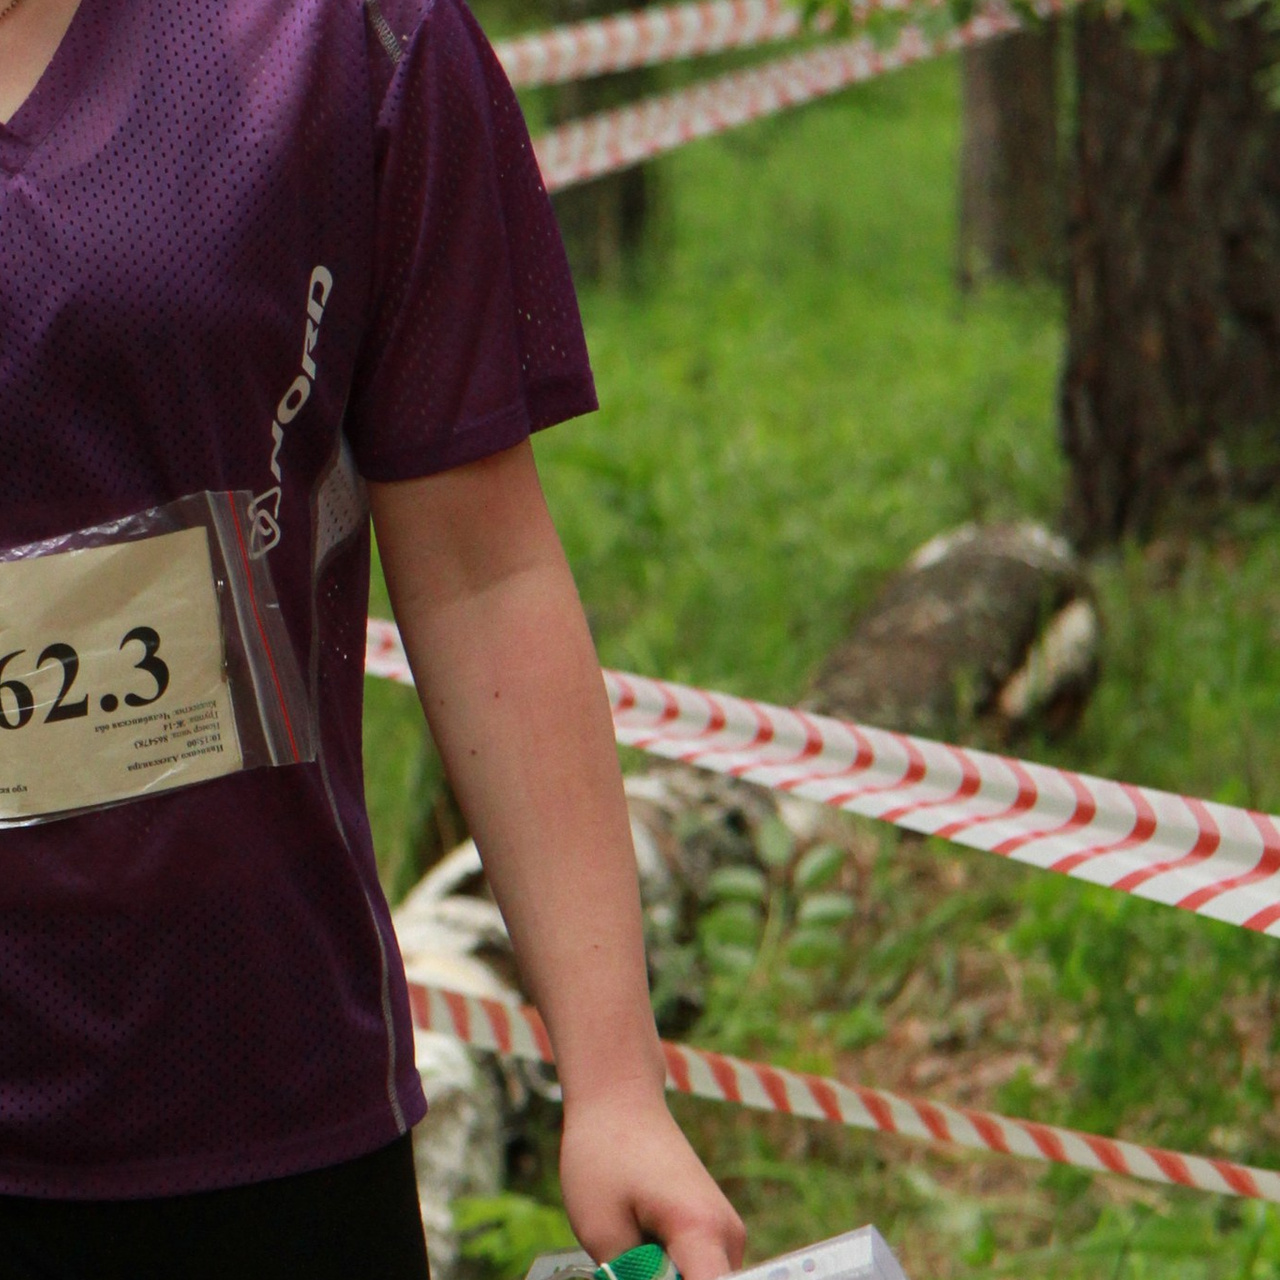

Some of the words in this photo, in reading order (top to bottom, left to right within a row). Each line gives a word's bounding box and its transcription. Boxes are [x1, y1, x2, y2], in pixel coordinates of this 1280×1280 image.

[112, 712, 171, 729] Челябинская
[187, 733, 222, 748] 10:15:00
[127, 755, 180, 772] Александра
[11, 784, 28, 793] обл
